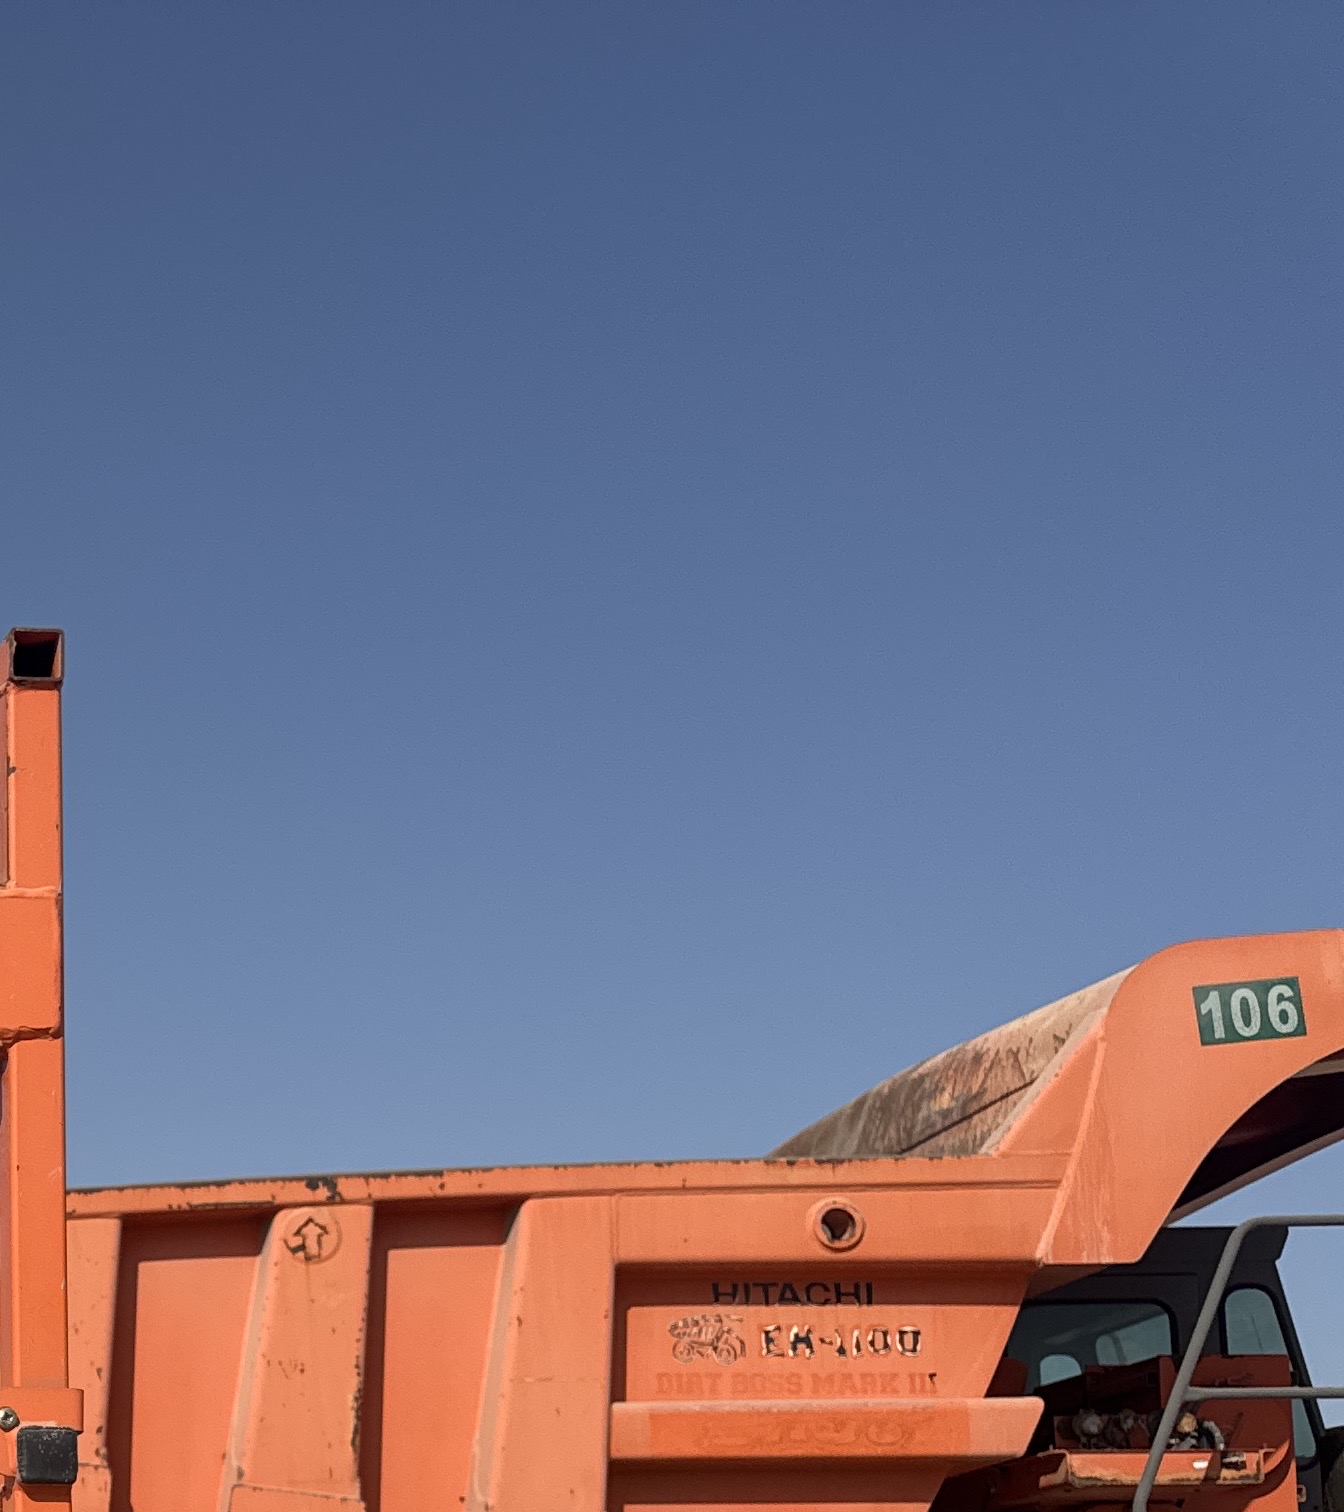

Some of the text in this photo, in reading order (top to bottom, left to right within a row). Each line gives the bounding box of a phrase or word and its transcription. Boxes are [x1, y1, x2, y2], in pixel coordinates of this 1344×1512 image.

[1200, 984, 1299, 1040] 106
[712, 1282, 874, 1306] HITACHI
[656, 1372, 722, 1394] DIRT
[731, 1372, 802, 1394] BOSS
[812, 1372, 899, 1395] MARK
